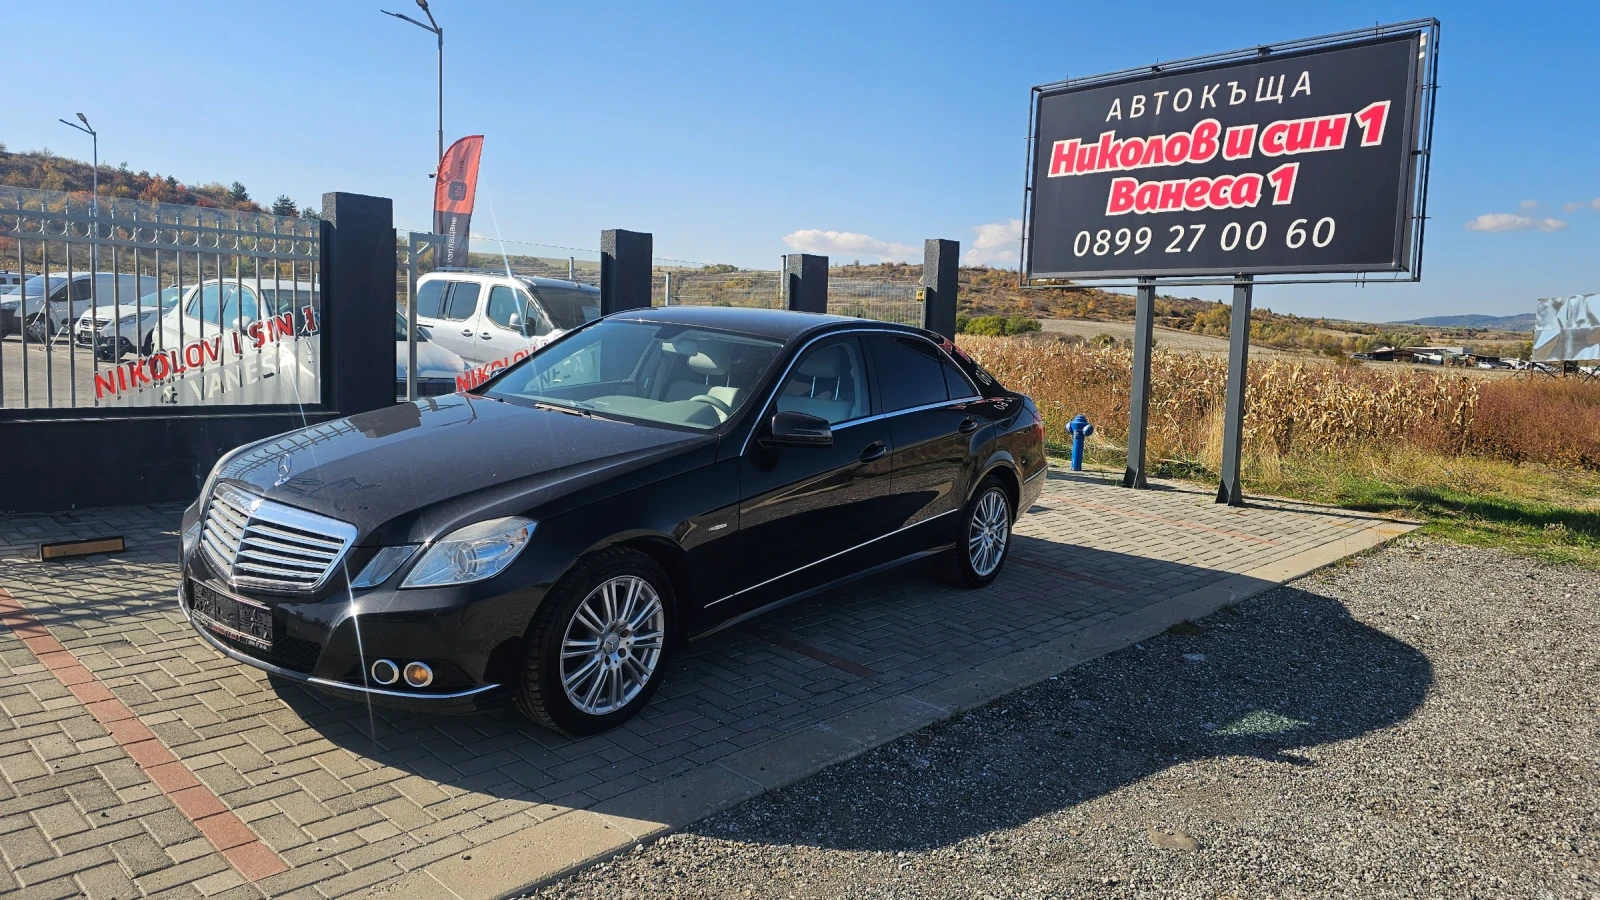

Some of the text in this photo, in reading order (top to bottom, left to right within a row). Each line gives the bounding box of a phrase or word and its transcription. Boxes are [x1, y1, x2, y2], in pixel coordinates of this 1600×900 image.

[1105, 71, 1311, 122] АВТОКЪЩА
[1047, 100, 1391, 178] Николов и син 1
[455, 159, 465, 180] bank
[1105, 162, 1300, 216] Ванеса 1
[446, 216, 458, 263] изплащане
[1073, 216, 1336, 257] 0899 27 00 60
[93, 334, 223, 401] NIKOLOV
[231, 329, 243, 355] I
[248, 312, 296, 350] SIN
